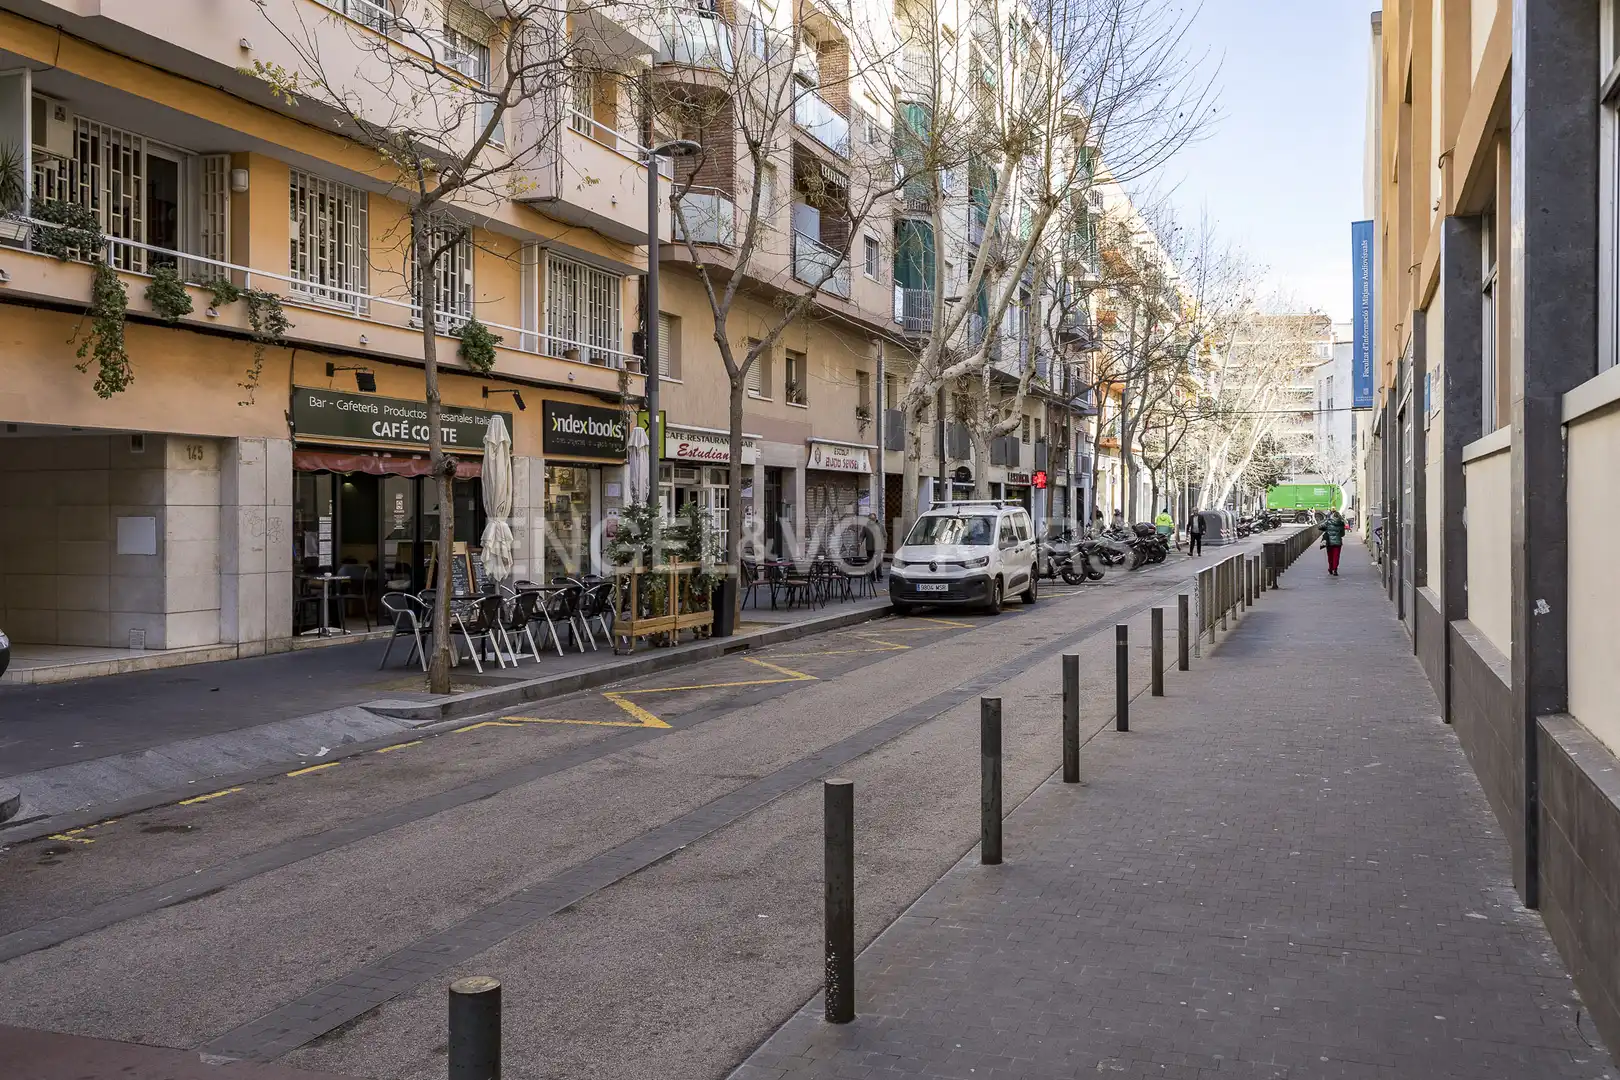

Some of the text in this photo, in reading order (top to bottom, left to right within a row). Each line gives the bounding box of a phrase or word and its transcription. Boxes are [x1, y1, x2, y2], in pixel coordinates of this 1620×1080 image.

[309, 396, 327, 408] Bar
[336, 400, 379, 414] Cafetería
[383, 405, 427, 420] Productos
[372, 420, 457, 443] CAFÉ COTE
[665, 431, 730, 445] CAFE-RESTAURAN
[185, 444, 203, 461] 145
[677, 443, 730, 460] Estudian
